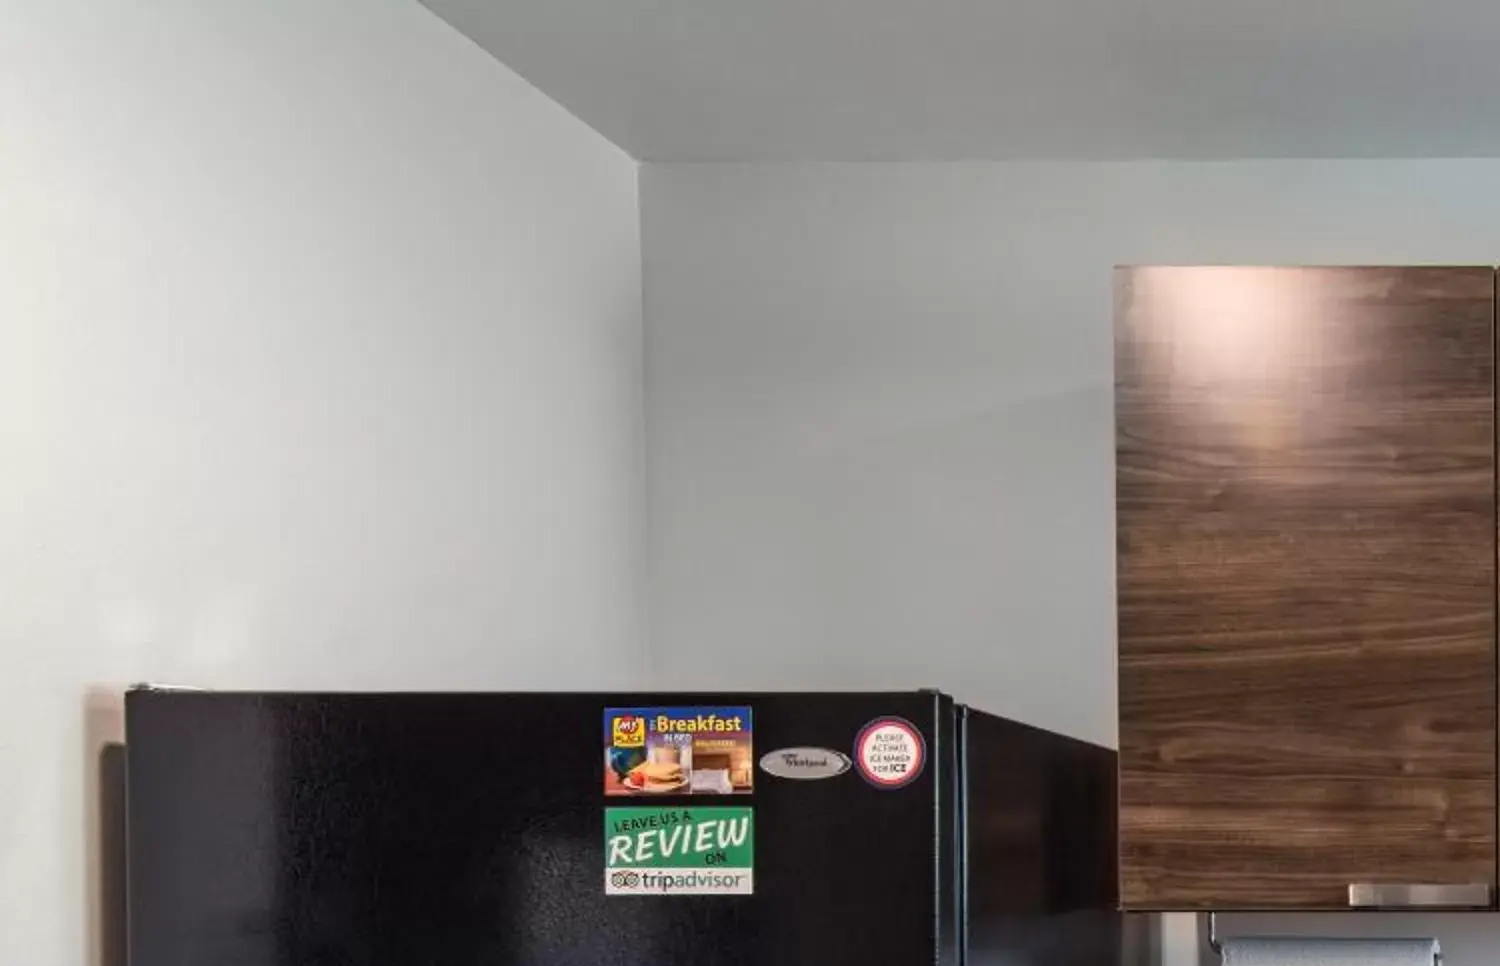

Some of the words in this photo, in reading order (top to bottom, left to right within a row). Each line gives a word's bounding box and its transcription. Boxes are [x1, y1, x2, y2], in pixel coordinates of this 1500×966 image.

[656, 715, 742, 732] Breakfast
[889, 764, 907, 773] ICE
[614, 815, 658, 833] LEAVE
[660, 811, 680, 826] US
[682, 810, 693, 822] A
[609, 816, 749, 866] REVIEW
[705, 852, 727, 866] ON
[642, 871, 741, 891] tripadvisor
